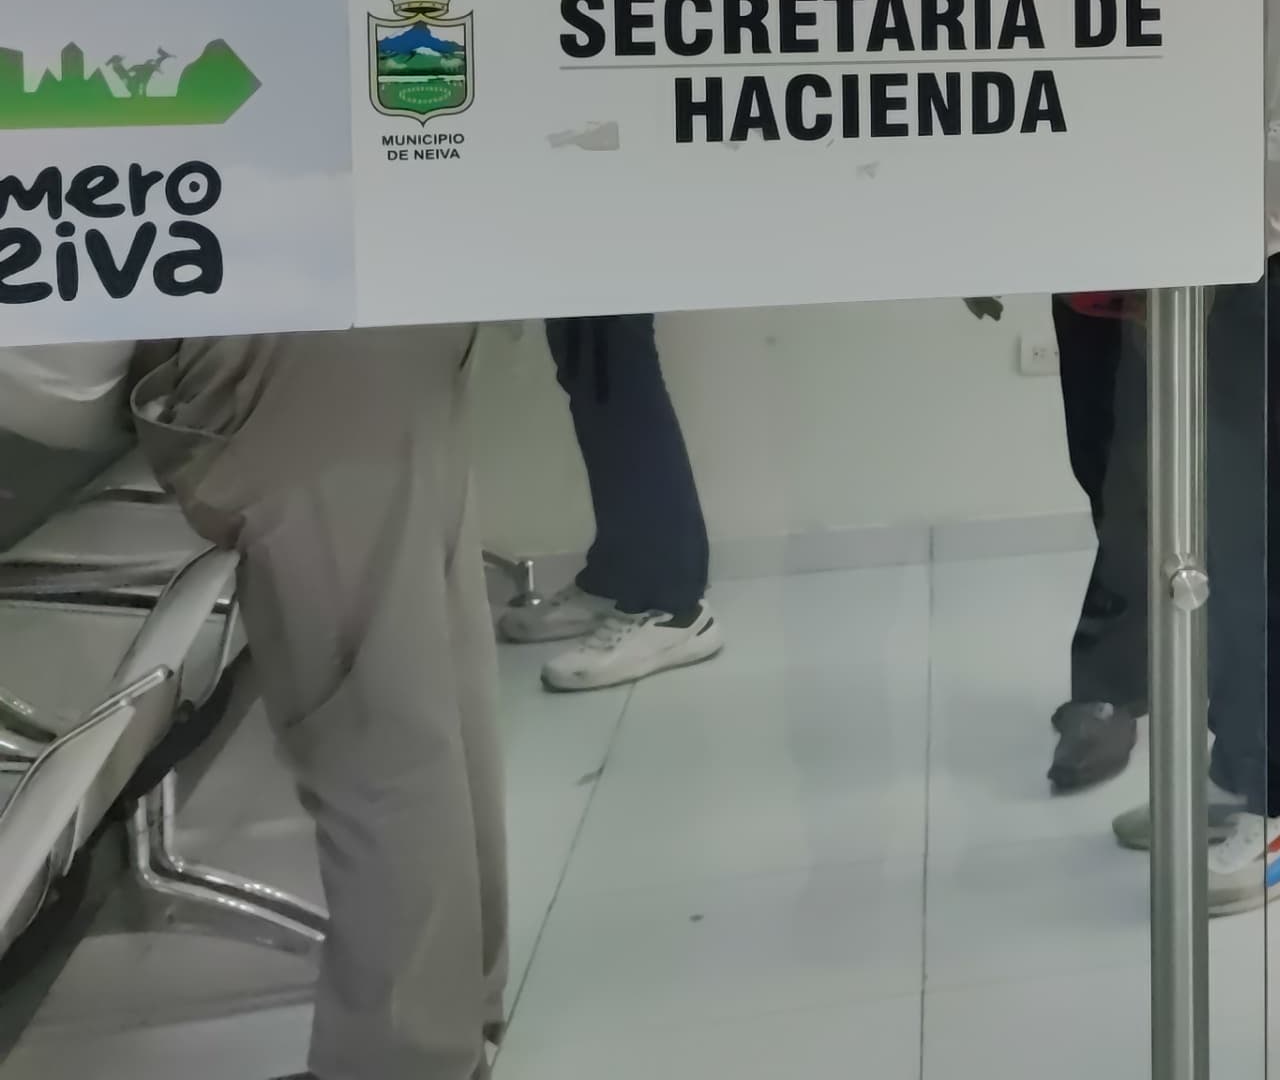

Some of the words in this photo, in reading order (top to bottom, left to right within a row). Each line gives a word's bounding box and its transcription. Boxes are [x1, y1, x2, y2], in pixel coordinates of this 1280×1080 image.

[674, 70, 1068, 144] HACIENDA
[381, 133, 465, 146] MUNICIPIO
[387, 149, 408, 161] DE
[414, 148, 460, 160] NEIVA
